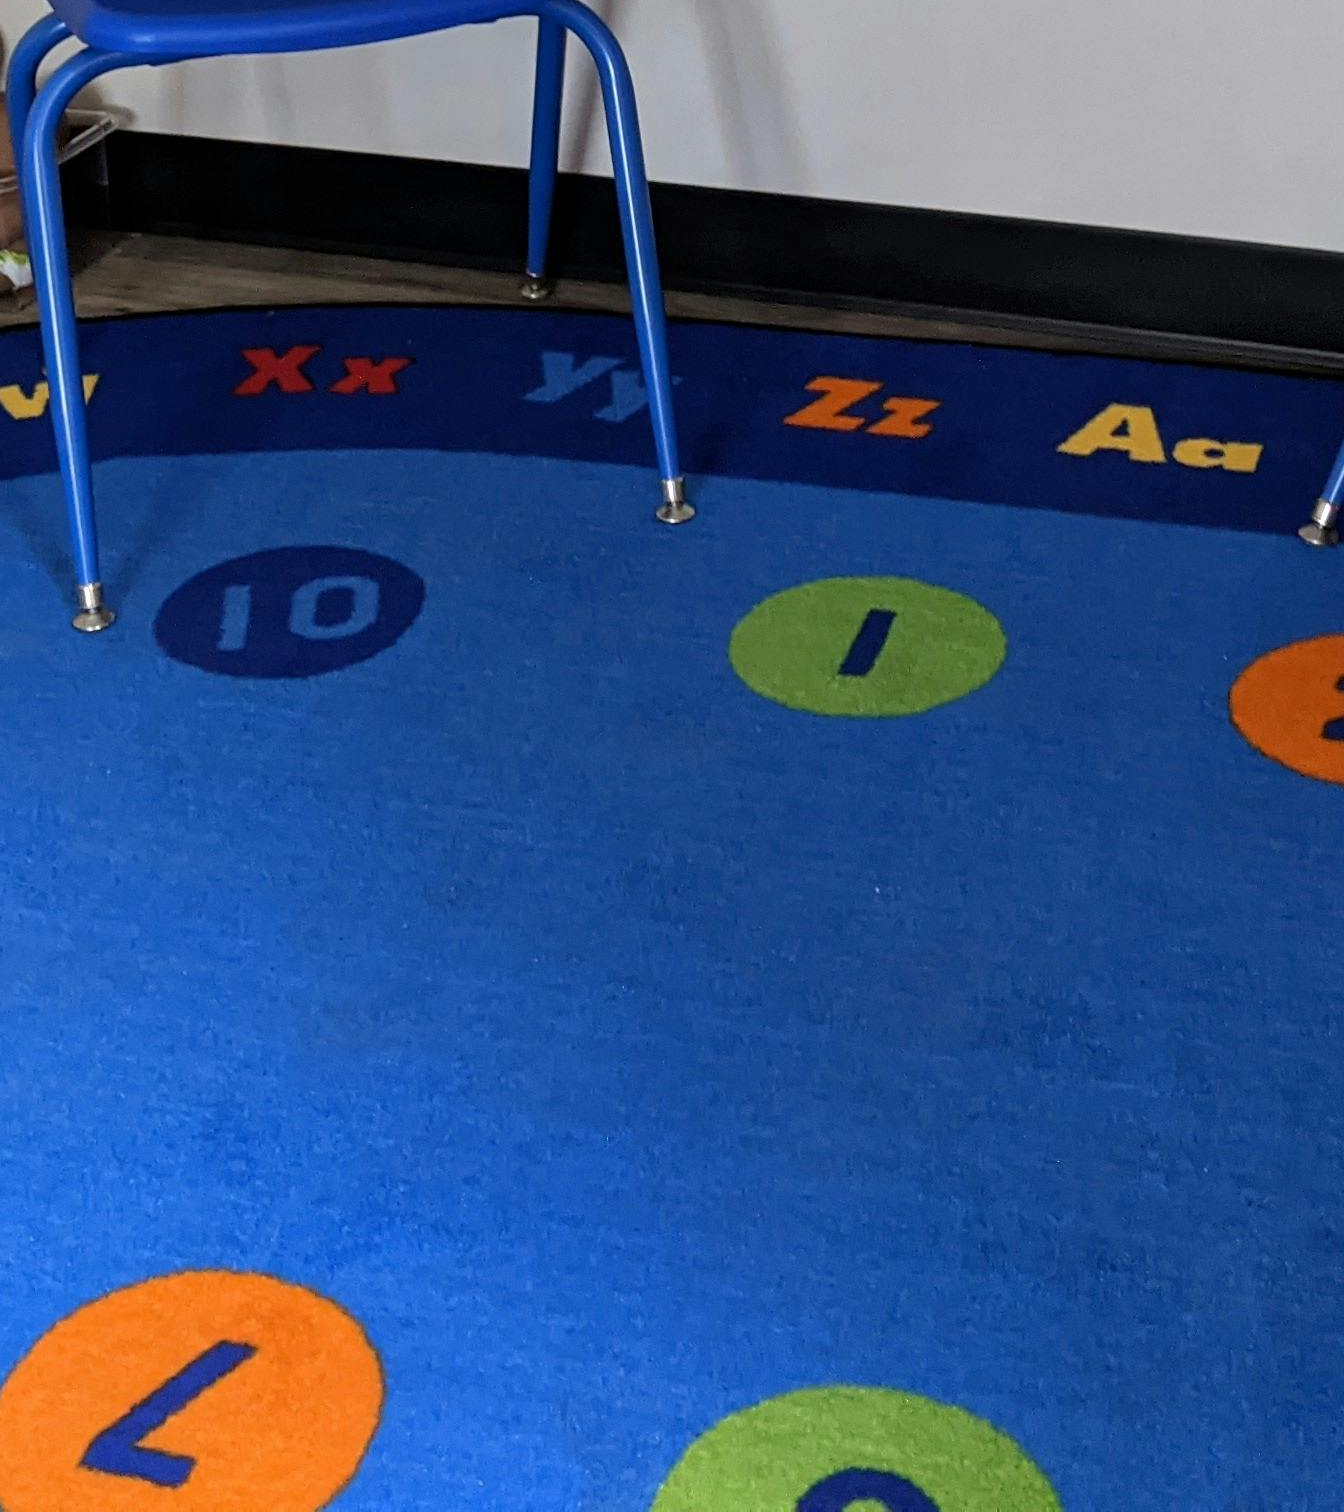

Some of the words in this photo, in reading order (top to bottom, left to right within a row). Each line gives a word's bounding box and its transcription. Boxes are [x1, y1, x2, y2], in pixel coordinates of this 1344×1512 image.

[1056, 404, 1264, 474] Aa
[216, 572, 380, 654] 10
[837, 608, 896, 677] 1
[78, 1339, 259, 1490] 7
